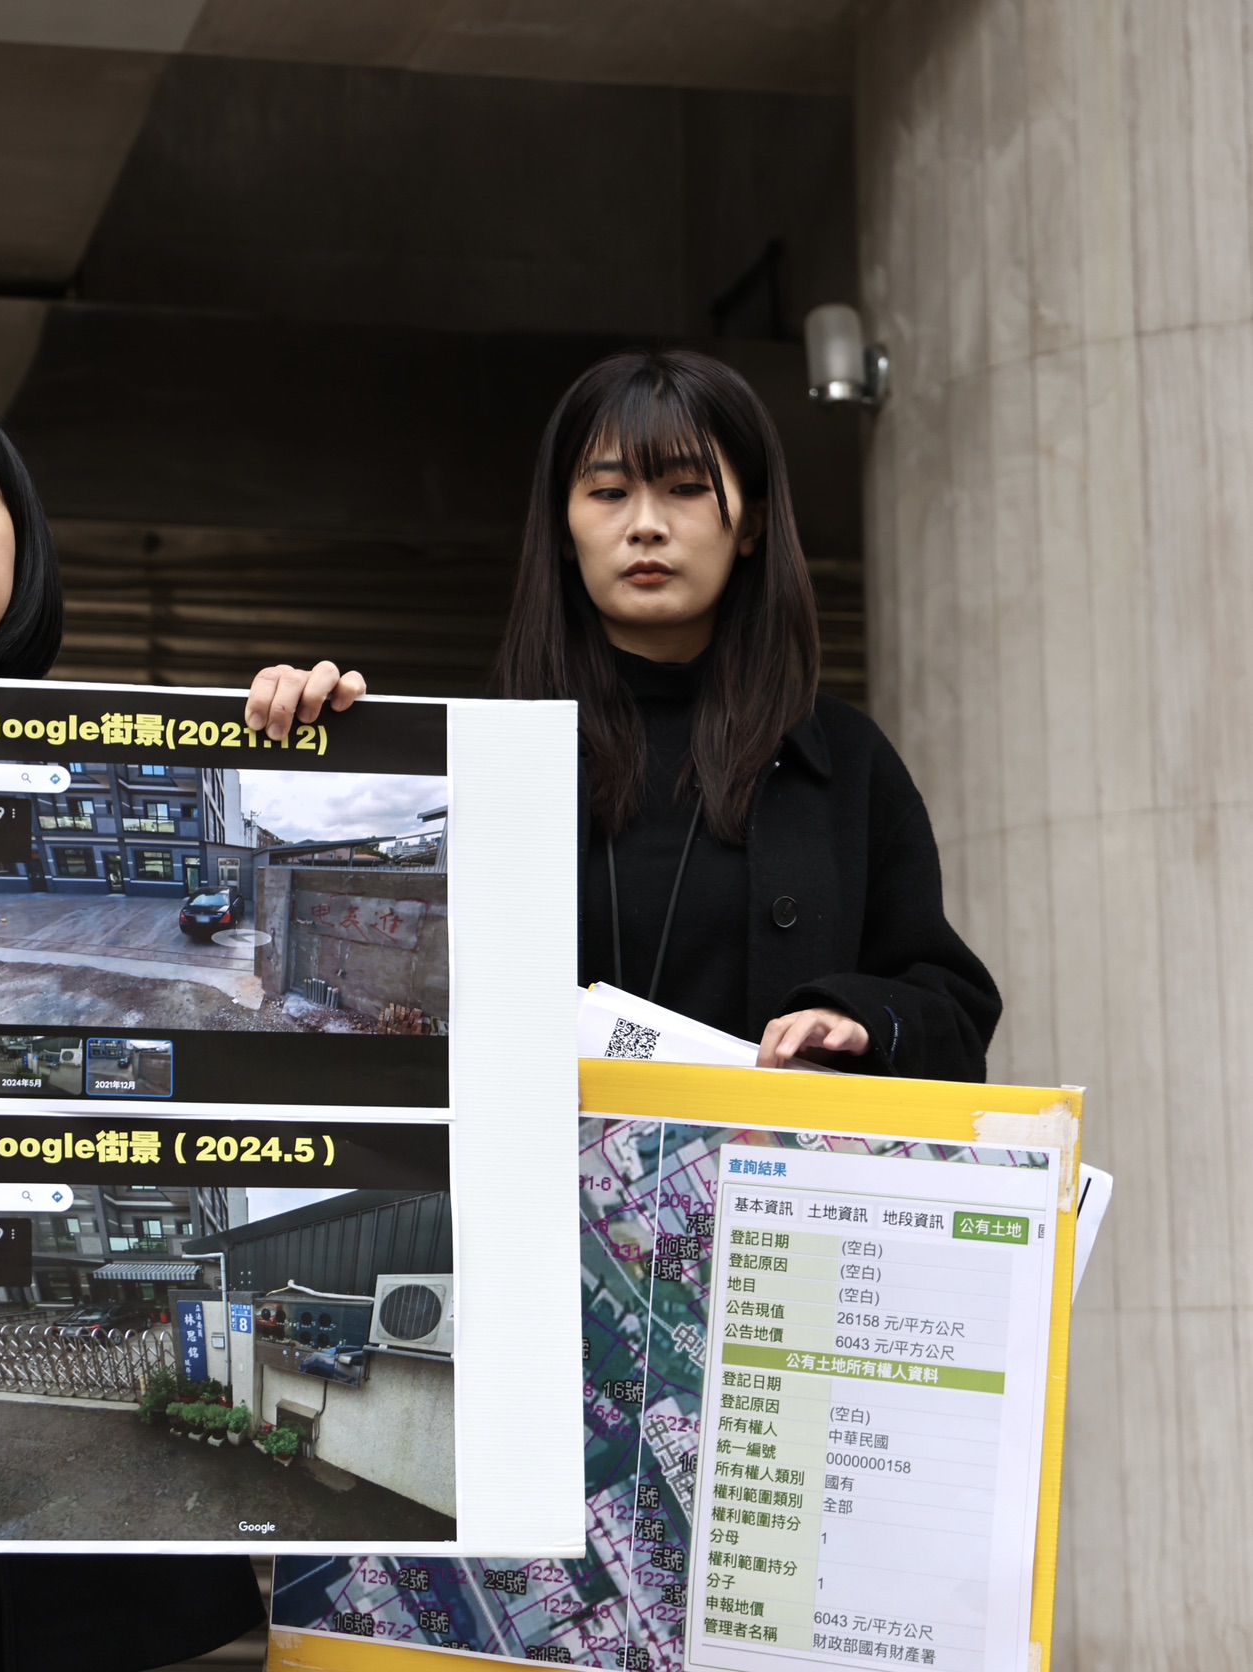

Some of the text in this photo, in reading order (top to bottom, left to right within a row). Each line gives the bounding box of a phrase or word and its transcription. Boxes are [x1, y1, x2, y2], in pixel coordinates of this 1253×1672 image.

[1, 1078, 42, 1089] 2024年5月
[95, 1080, 136, 1091] 2021年12月
[728, 1157, 787, 1178] 查詢結果
[734, 1197, 793, 1217] 基本資訊
[807, 1204, 868, 1224] 土地資訊
[882, 1210, 944, 1230] 地段資訊
[959, 1217, 1022, 1239] 公有土地
[730, 1229, 883, 1259] 登記日期 (空白)
[728, 1252, 882, 1284] 登記原因 (空白)
[727, 1276, 880, 1307] 地目 (空白)
[239, 1317, 248, 1332] 8
[726, 1299, 965, 1338] 公告現值 26158 元/平方公尺
[724, 1323, 955, 1361] 公告地價 6043 元/平方公尺
[722, 1371, 782, 1391] 登記日期
[786, 1352, 939, 1384] 公有土地所有權人資料
[720, 1393, 871, 1426] 登記原因 (空白)
[718, 1416, 889, 1450] 所有權人 中華民國
[716, 1438, 911, 1474] 統一編號 0000000158
[714, 1460, 855, 1492] 所有權人類別 國有
[712, 1483, 853, 1515] 權利範圍類別 全部
[238, 1520, 276, 1534] Google
[711, 1505, 801, 1531] 權利範圍持分
[710, 1528, 827, 1545] 分母 1
[707, 1550, 798, 1576] 權利範圍持分
[706, 1573, 824, 1590] 分子 1
[706, 1595, 934, 1641] 申報地價 6043 元/平方公尺
[704, 1617, 936, 1665] 管理者名稱 財政部國有財產署
